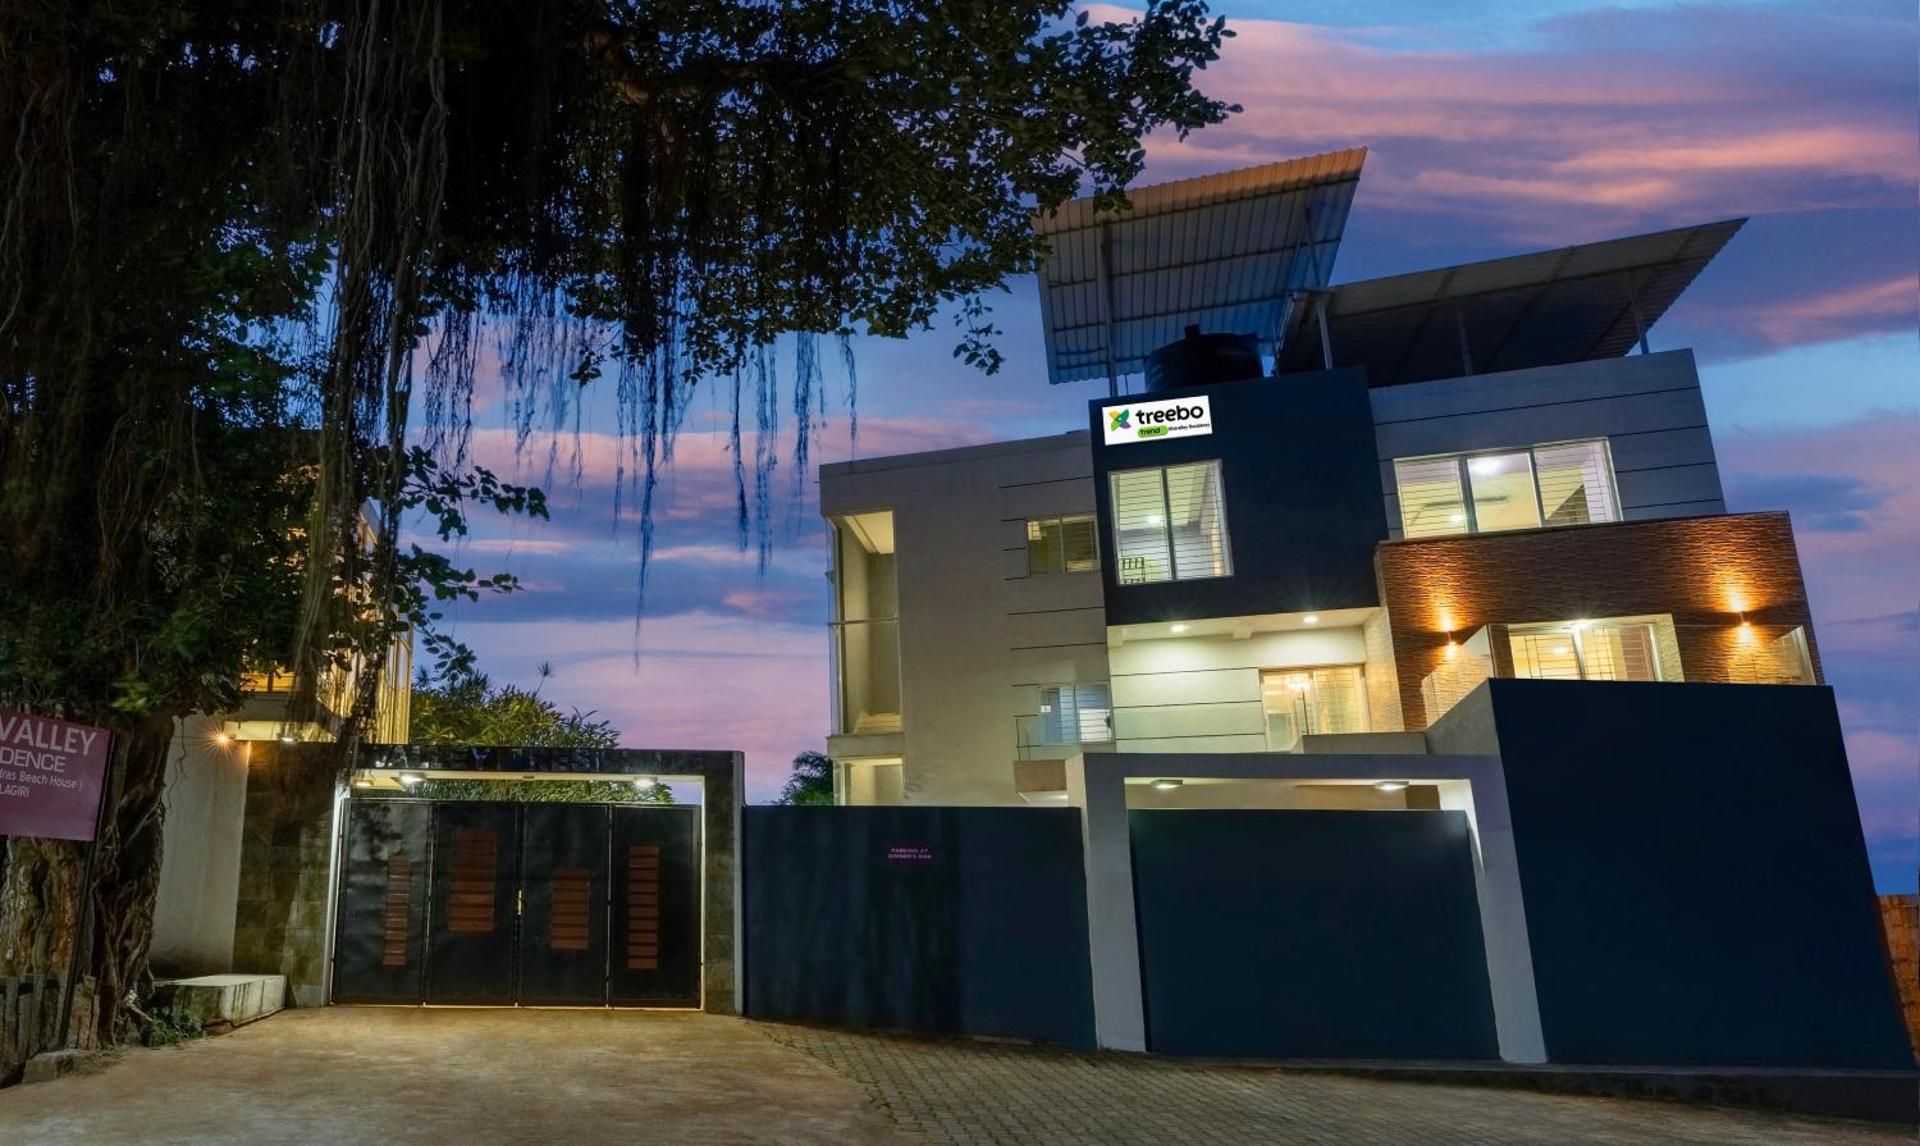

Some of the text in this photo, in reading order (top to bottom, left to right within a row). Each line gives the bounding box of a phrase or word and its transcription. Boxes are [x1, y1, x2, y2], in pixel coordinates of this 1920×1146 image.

[1136, 405, 1204, 424] treebo
[0, 715, 97, 756] VALLEY
[20, 771, 47, 785] Beach
